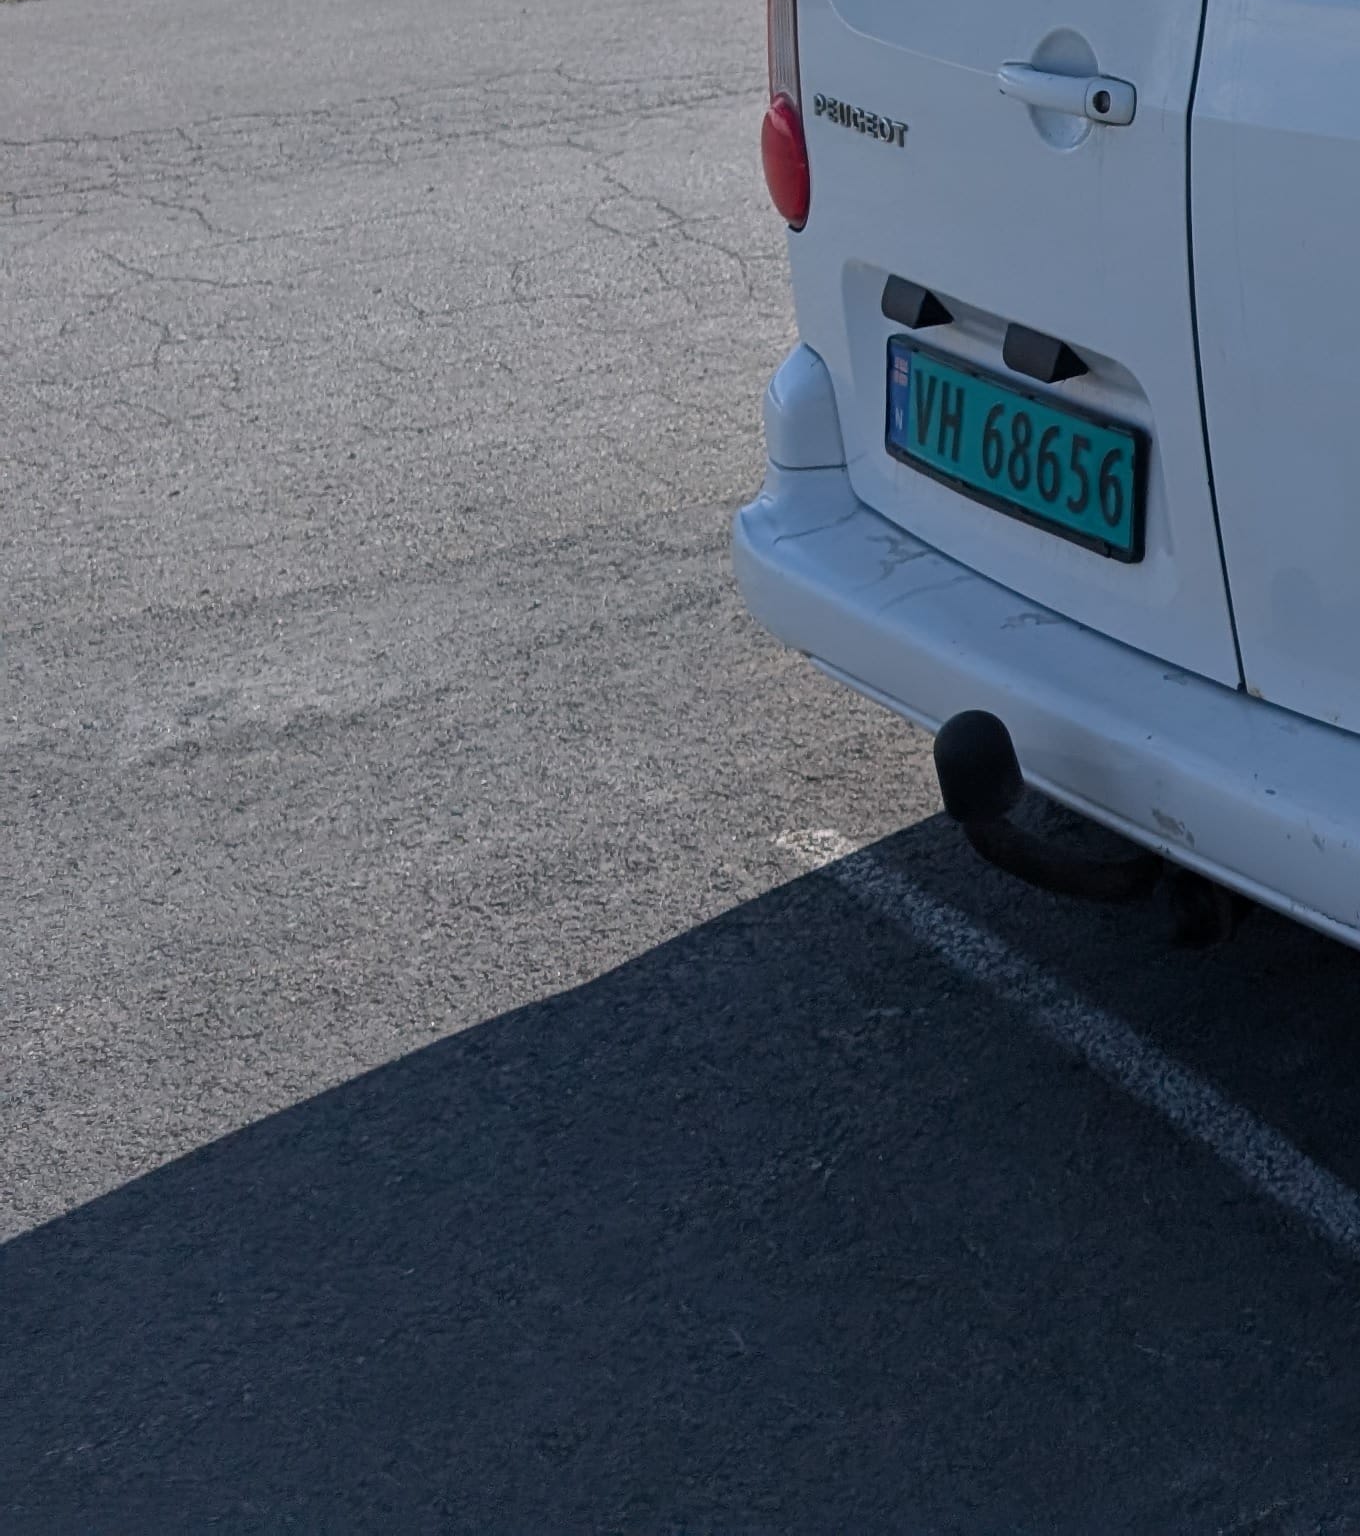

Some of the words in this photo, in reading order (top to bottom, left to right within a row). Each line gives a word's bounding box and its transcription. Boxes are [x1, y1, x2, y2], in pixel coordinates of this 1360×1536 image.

[813, 92, 909, 148] PEUGEOT
[914, 368, 966, 463] VH
[982, 401, 1124, 529] 68656
